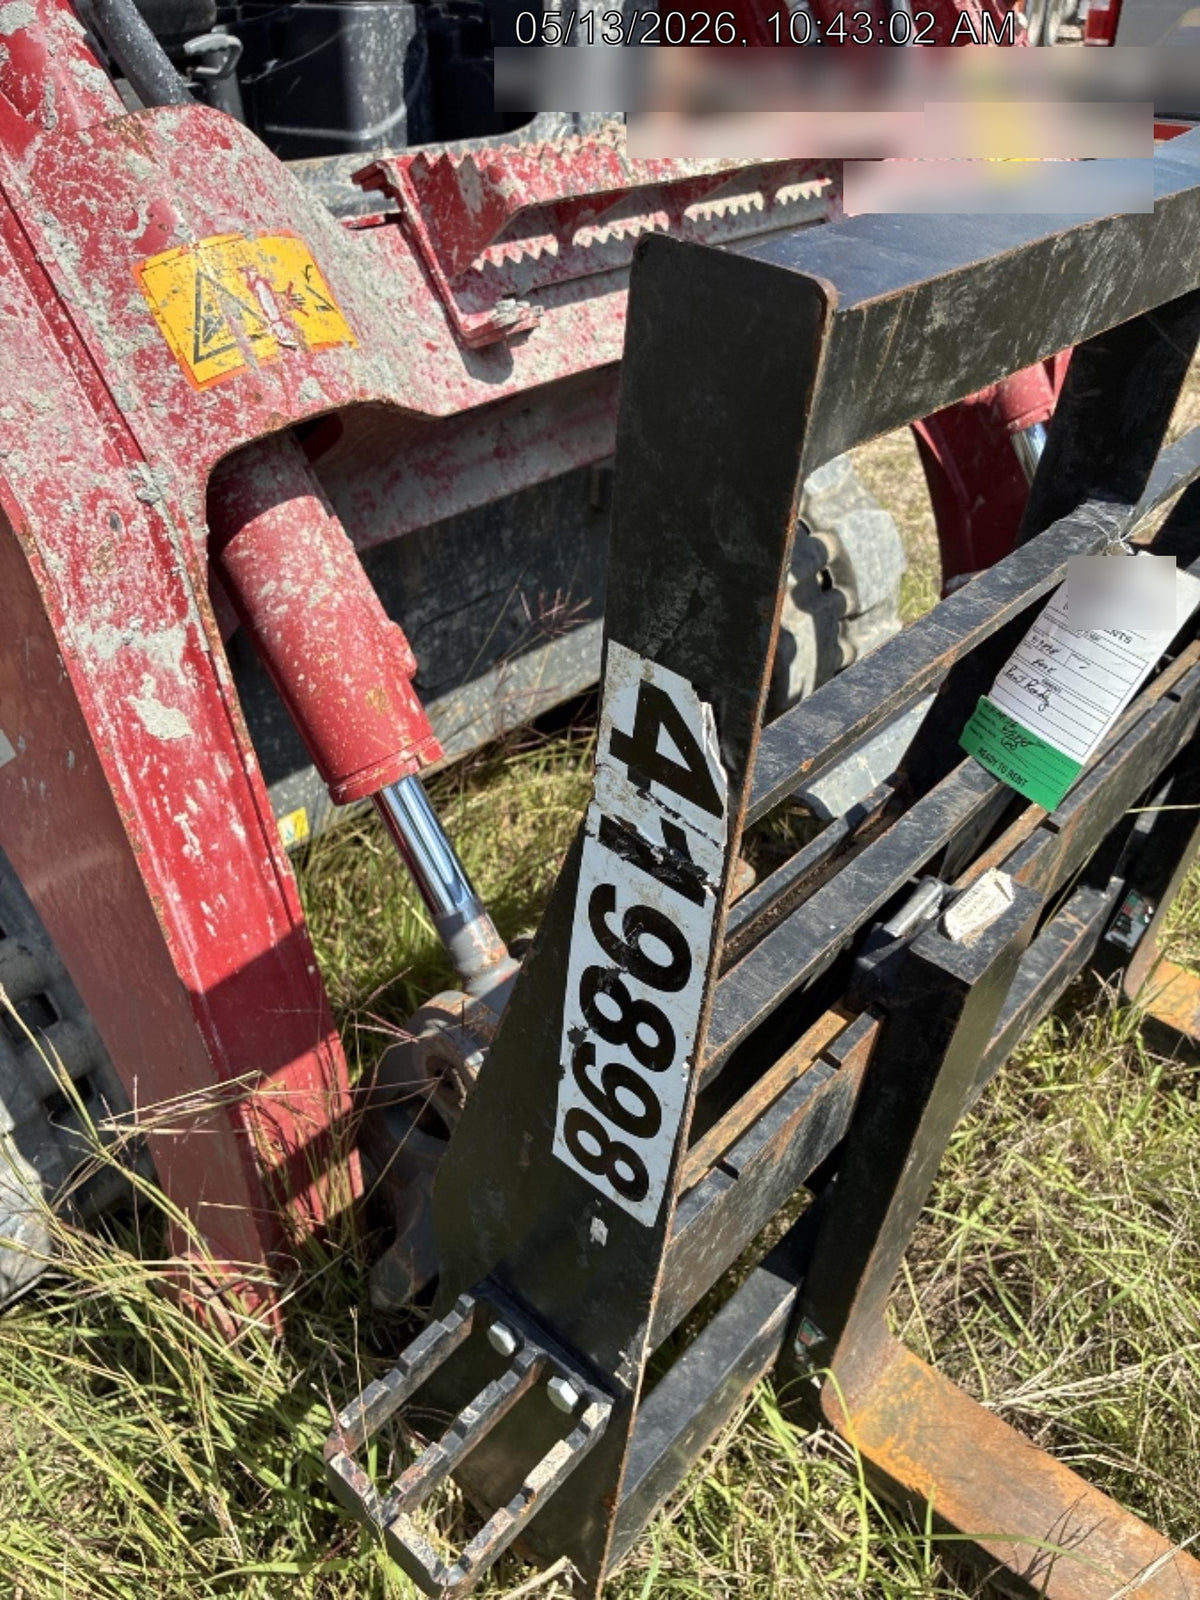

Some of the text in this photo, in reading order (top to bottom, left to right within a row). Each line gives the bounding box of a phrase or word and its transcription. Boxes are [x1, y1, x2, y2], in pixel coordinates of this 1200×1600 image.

[978, 746, 1029, 788] READY TO RENT
[563, 678, 726, 1203] 419898
